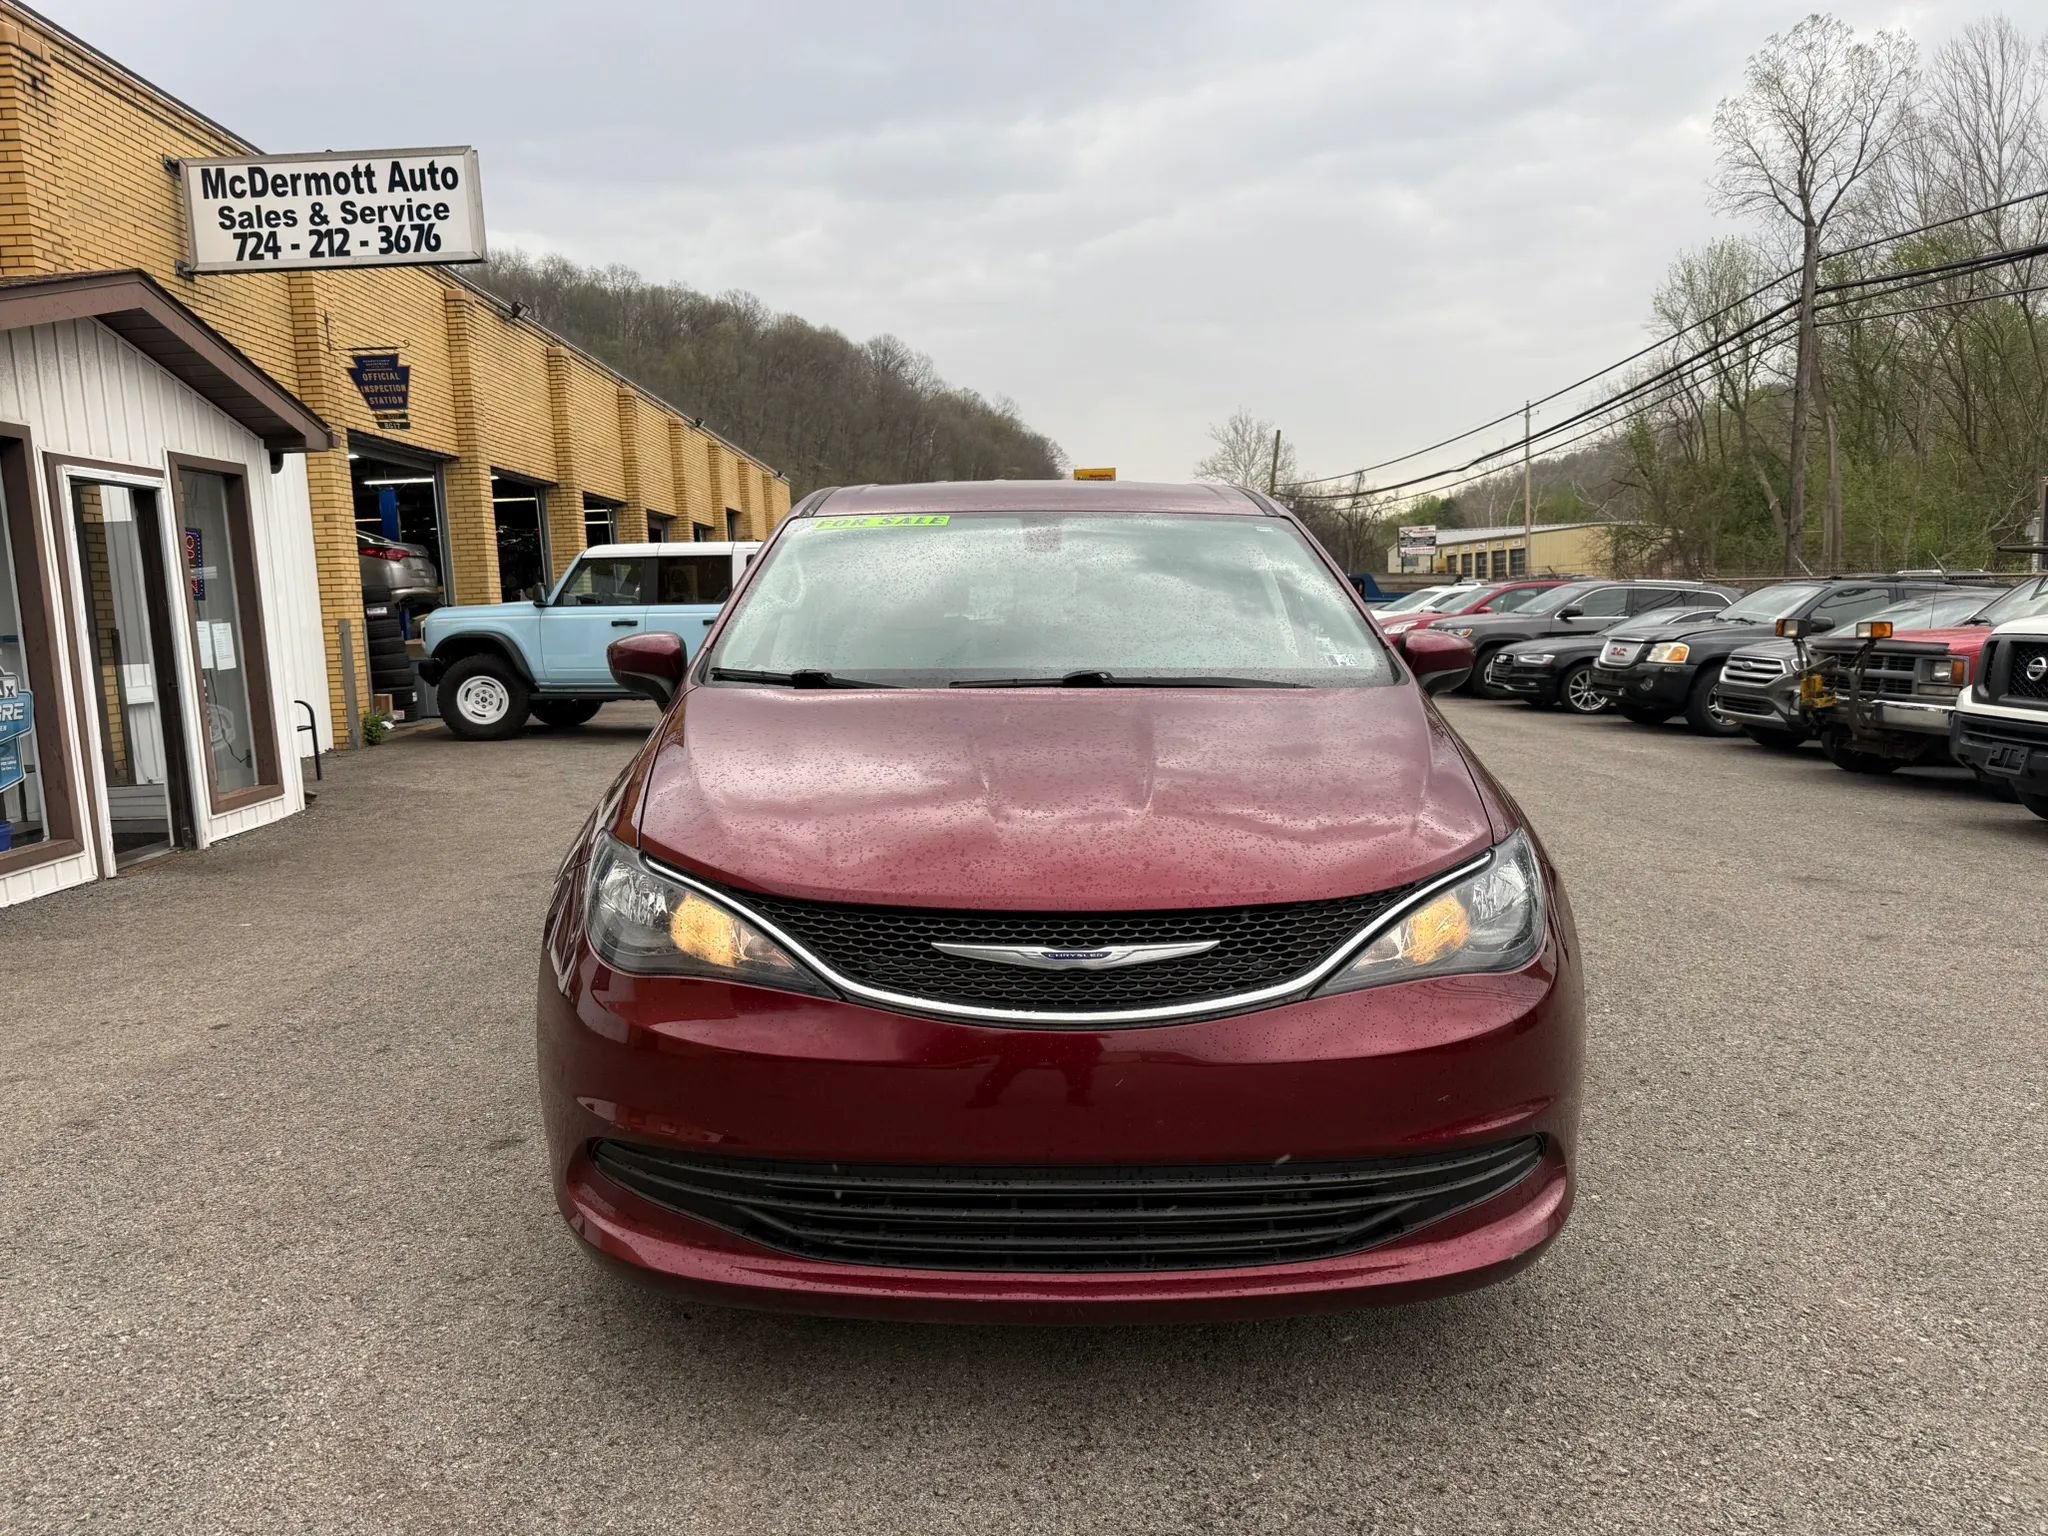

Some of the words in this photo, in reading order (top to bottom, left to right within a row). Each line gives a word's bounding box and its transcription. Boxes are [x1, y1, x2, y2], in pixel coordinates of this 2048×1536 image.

[200, 162, 377, 200] McDermott
[387, 159, 459, 193] Auto
[217, 204, 298, 230] Sales
[308, 201, 331, 226] &
[340, 198, 450, 225] Service
[232, 231, 282, 261] 724
[308, 228, 351, 258] 212
[377, 223, 442, 255] 3676
[362, 372, 400, 381] OFFICIAL
[360, 384, 407, 393] INSPECTION
[368, 396, 404, 405] STATION
[817, 519, 867, 527] FOR
[879, 516, 946, 525] SALE
